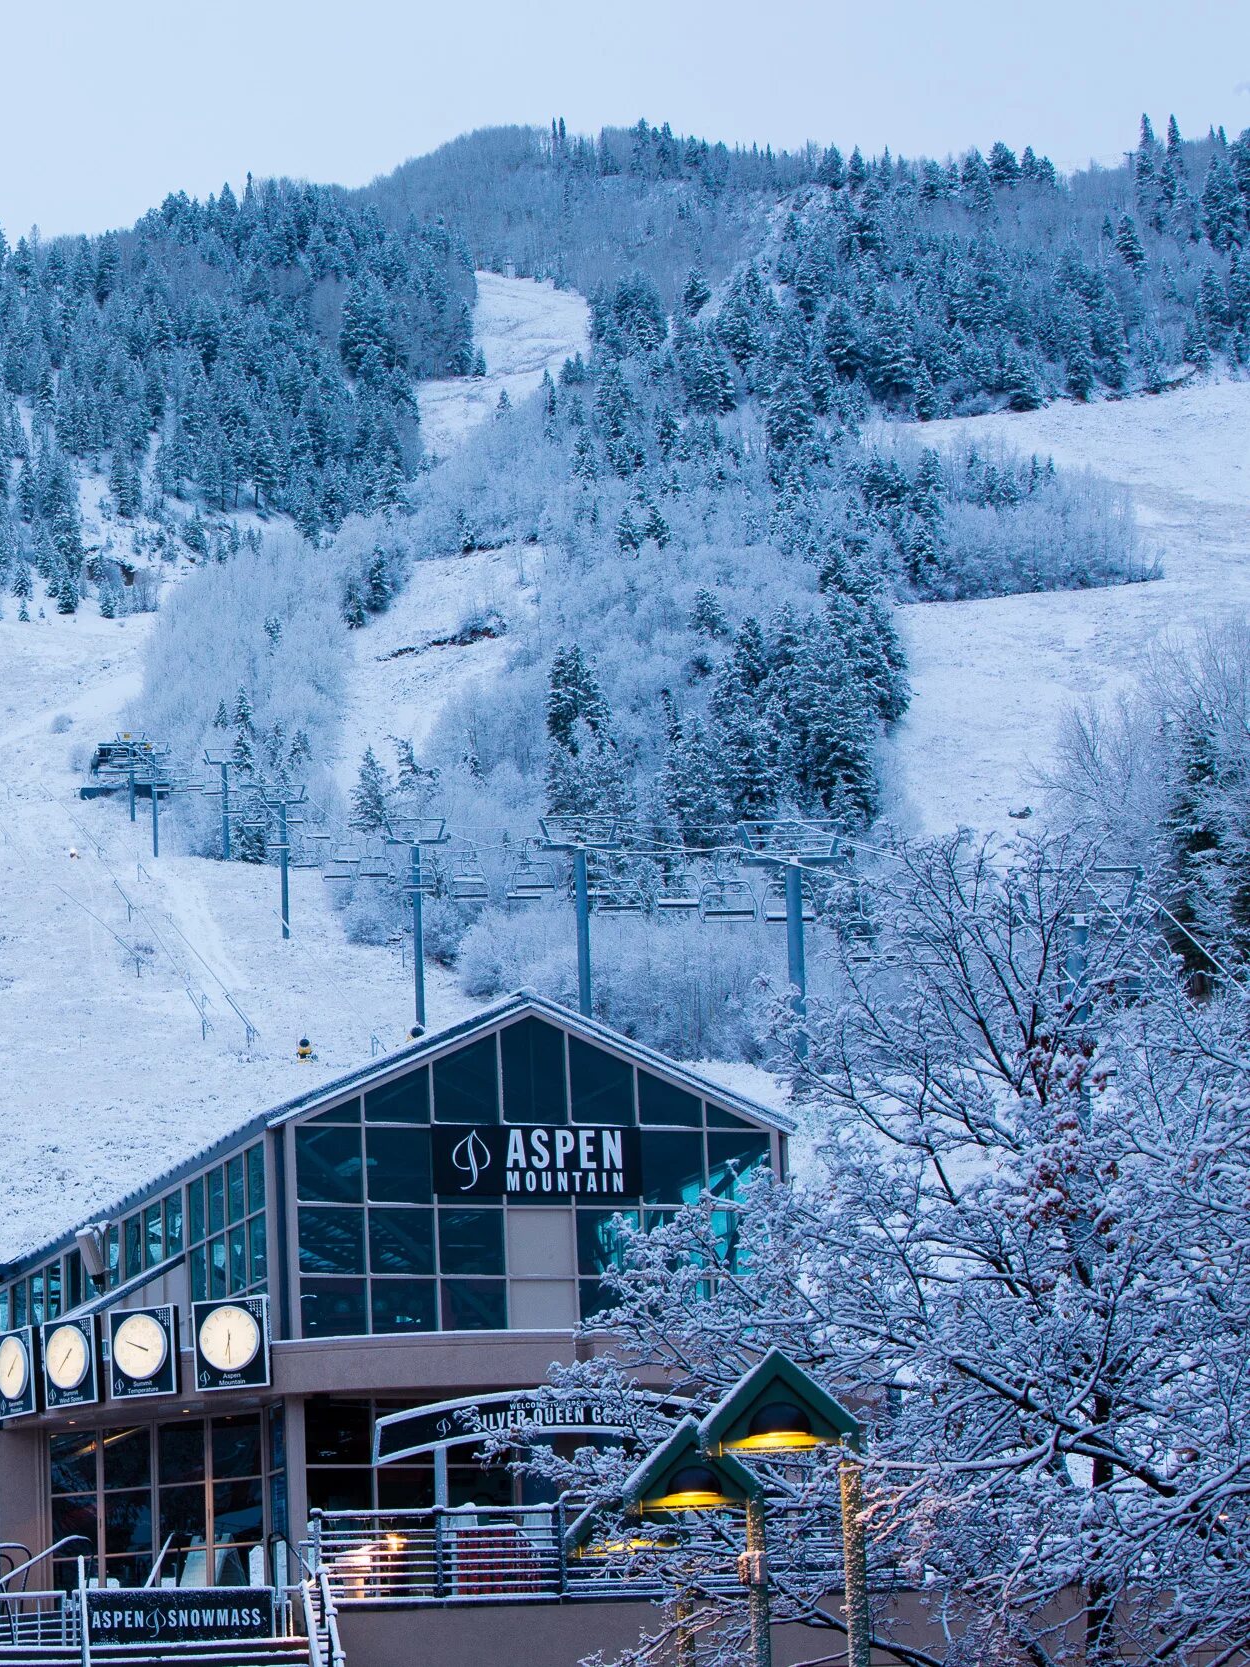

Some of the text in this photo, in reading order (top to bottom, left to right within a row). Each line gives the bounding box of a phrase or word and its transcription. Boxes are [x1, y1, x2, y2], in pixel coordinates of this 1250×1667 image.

[506, 1129, 623, 1170] ASPEN
[506, 1171, 624, 1193] MOUNTAIN
[533, 1407, 585, 1424] QUEEN
[92, 1608, 261, 1628] ASPEN SNOWMASS
